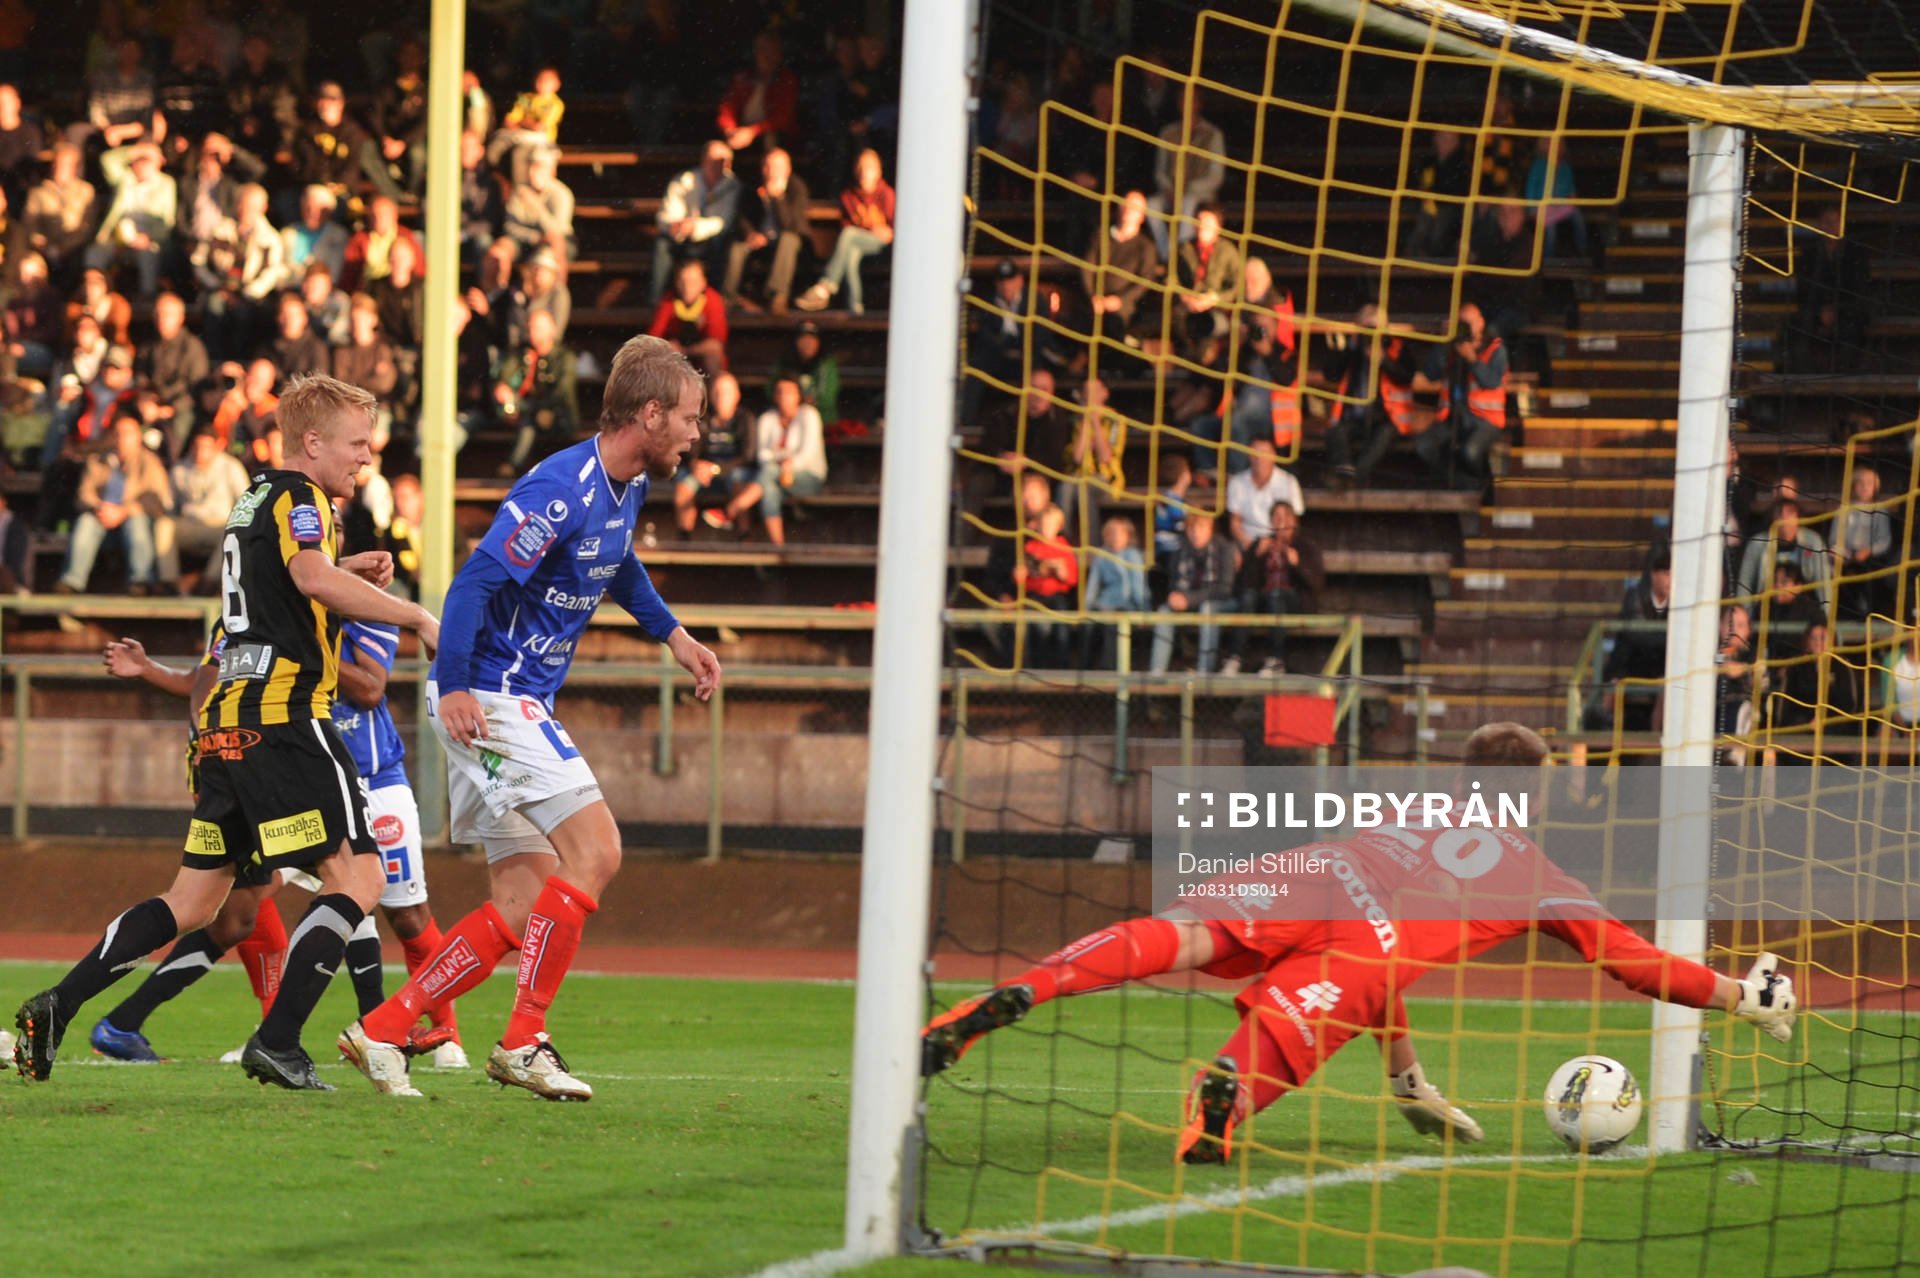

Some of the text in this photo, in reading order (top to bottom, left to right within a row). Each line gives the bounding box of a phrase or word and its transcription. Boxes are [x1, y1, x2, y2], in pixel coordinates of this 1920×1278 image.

[221, 532, 250, 634] 8
[204, 839, 222, 851] trä
[263, 817, 320, 840] kungälvs
[304, 827, 323, 843] trä
[1308, 848, 1399, 954] Corren
[524, 918, 547, 957] TEAM
[440, 945, 475, 978] TEAM
